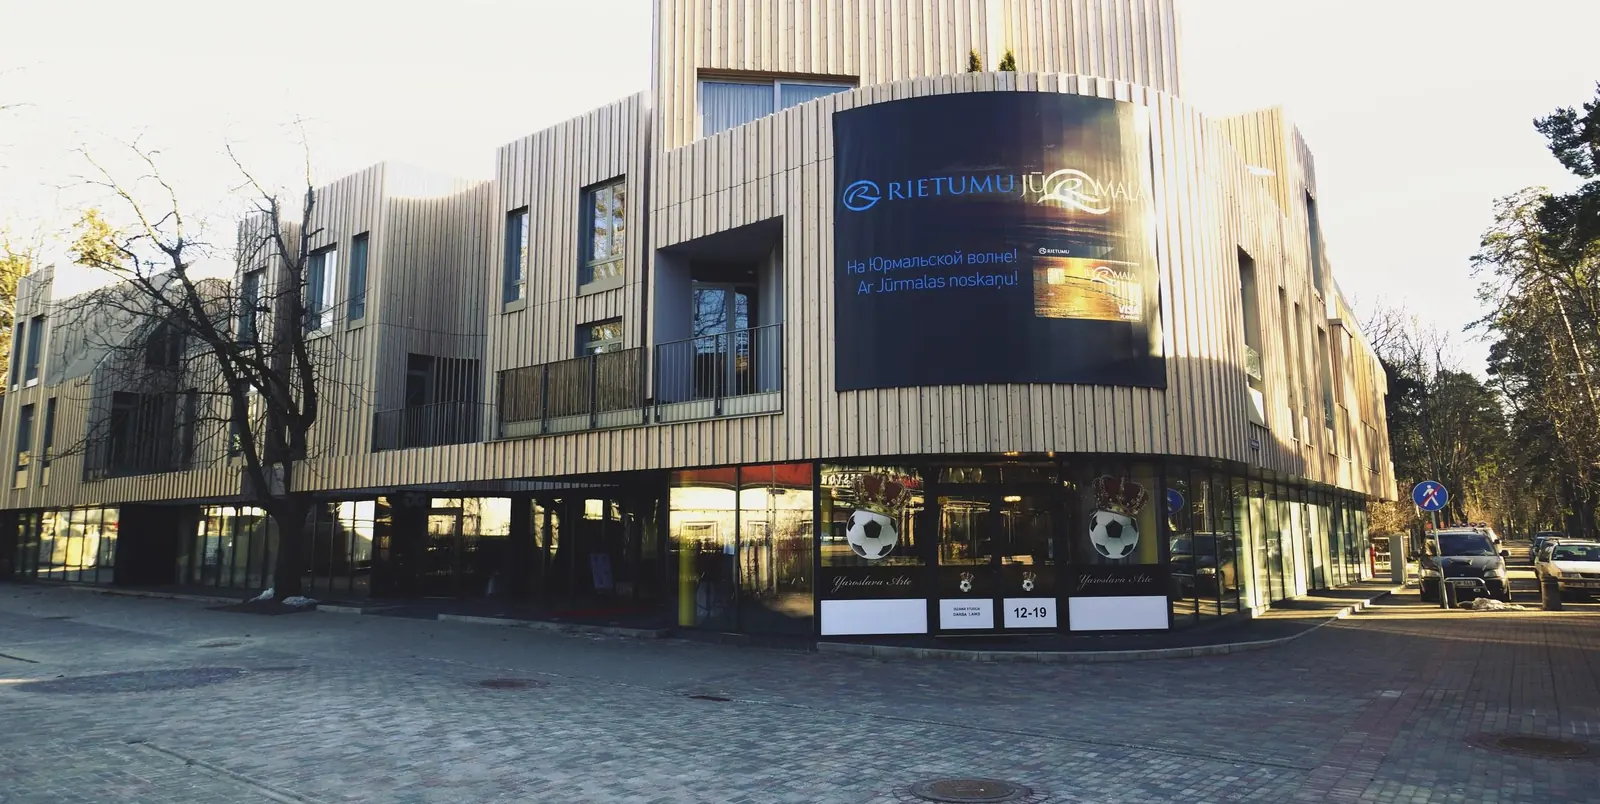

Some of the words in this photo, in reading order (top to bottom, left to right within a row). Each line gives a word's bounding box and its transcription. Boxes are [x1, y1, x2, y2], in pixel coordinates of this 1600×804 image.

[888, 174, 1014, 200] RIETUMU
[847, 260, 865, 275] На
[869, 250, 963, 274] Юрмальской
[967, 248, 1017, 265] волне!
[857, 280, 874, 295] Ar
[877, 274, 946, 293] Jūrmalas
[949, 270, 1019, 290] noskaņu!
[1013, 606, 1047, 618] 12-19
